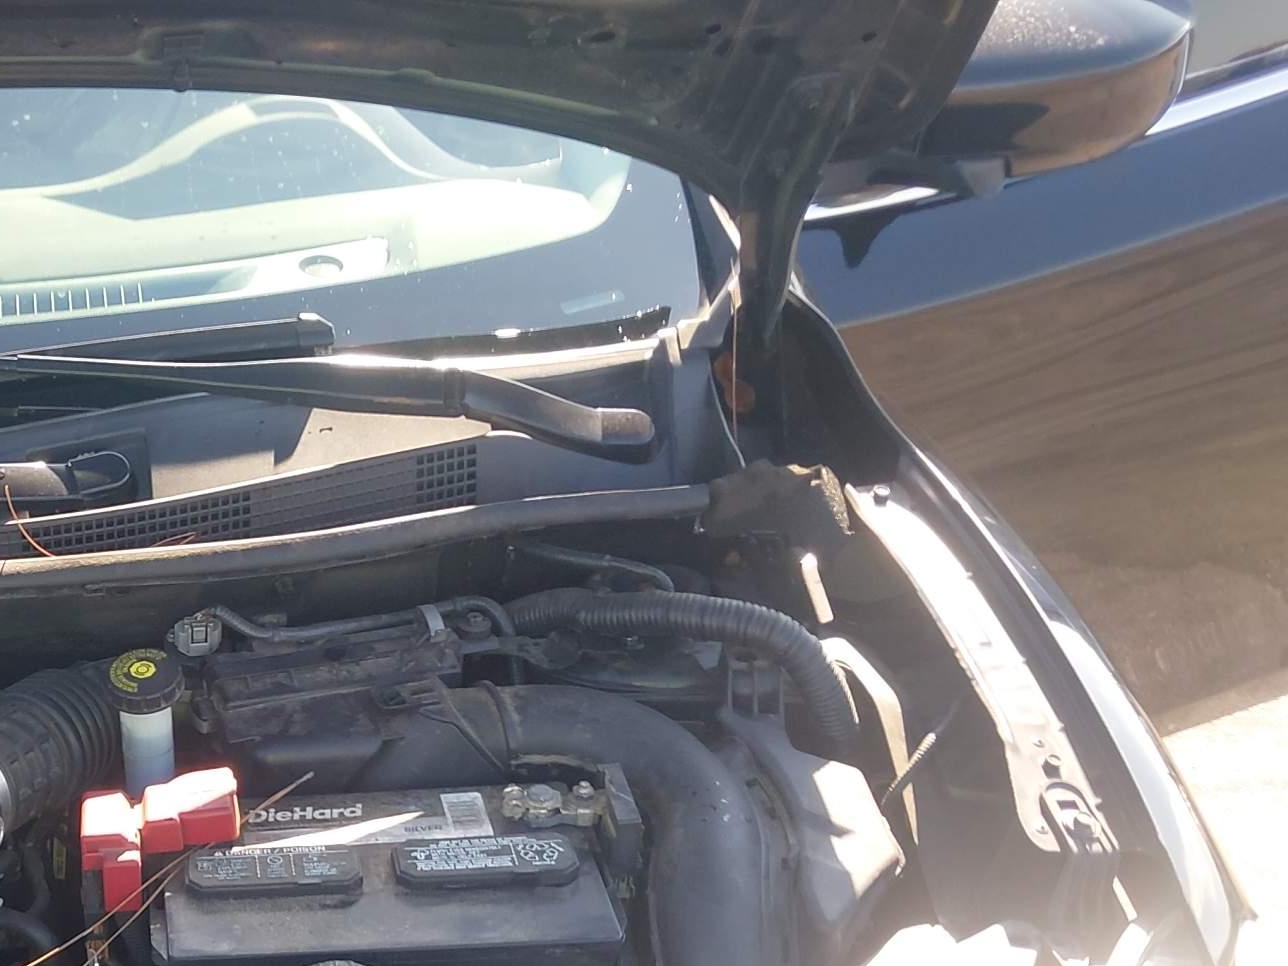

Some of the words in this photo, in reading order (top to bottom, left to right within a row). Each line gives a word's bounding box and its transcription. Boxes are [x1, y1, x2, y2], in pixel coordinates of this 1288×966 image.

[248, 803, 363, 824] DieHard
[404, 825, 443, 833] SILVER
[225, 847, 272, 855] DANGER
